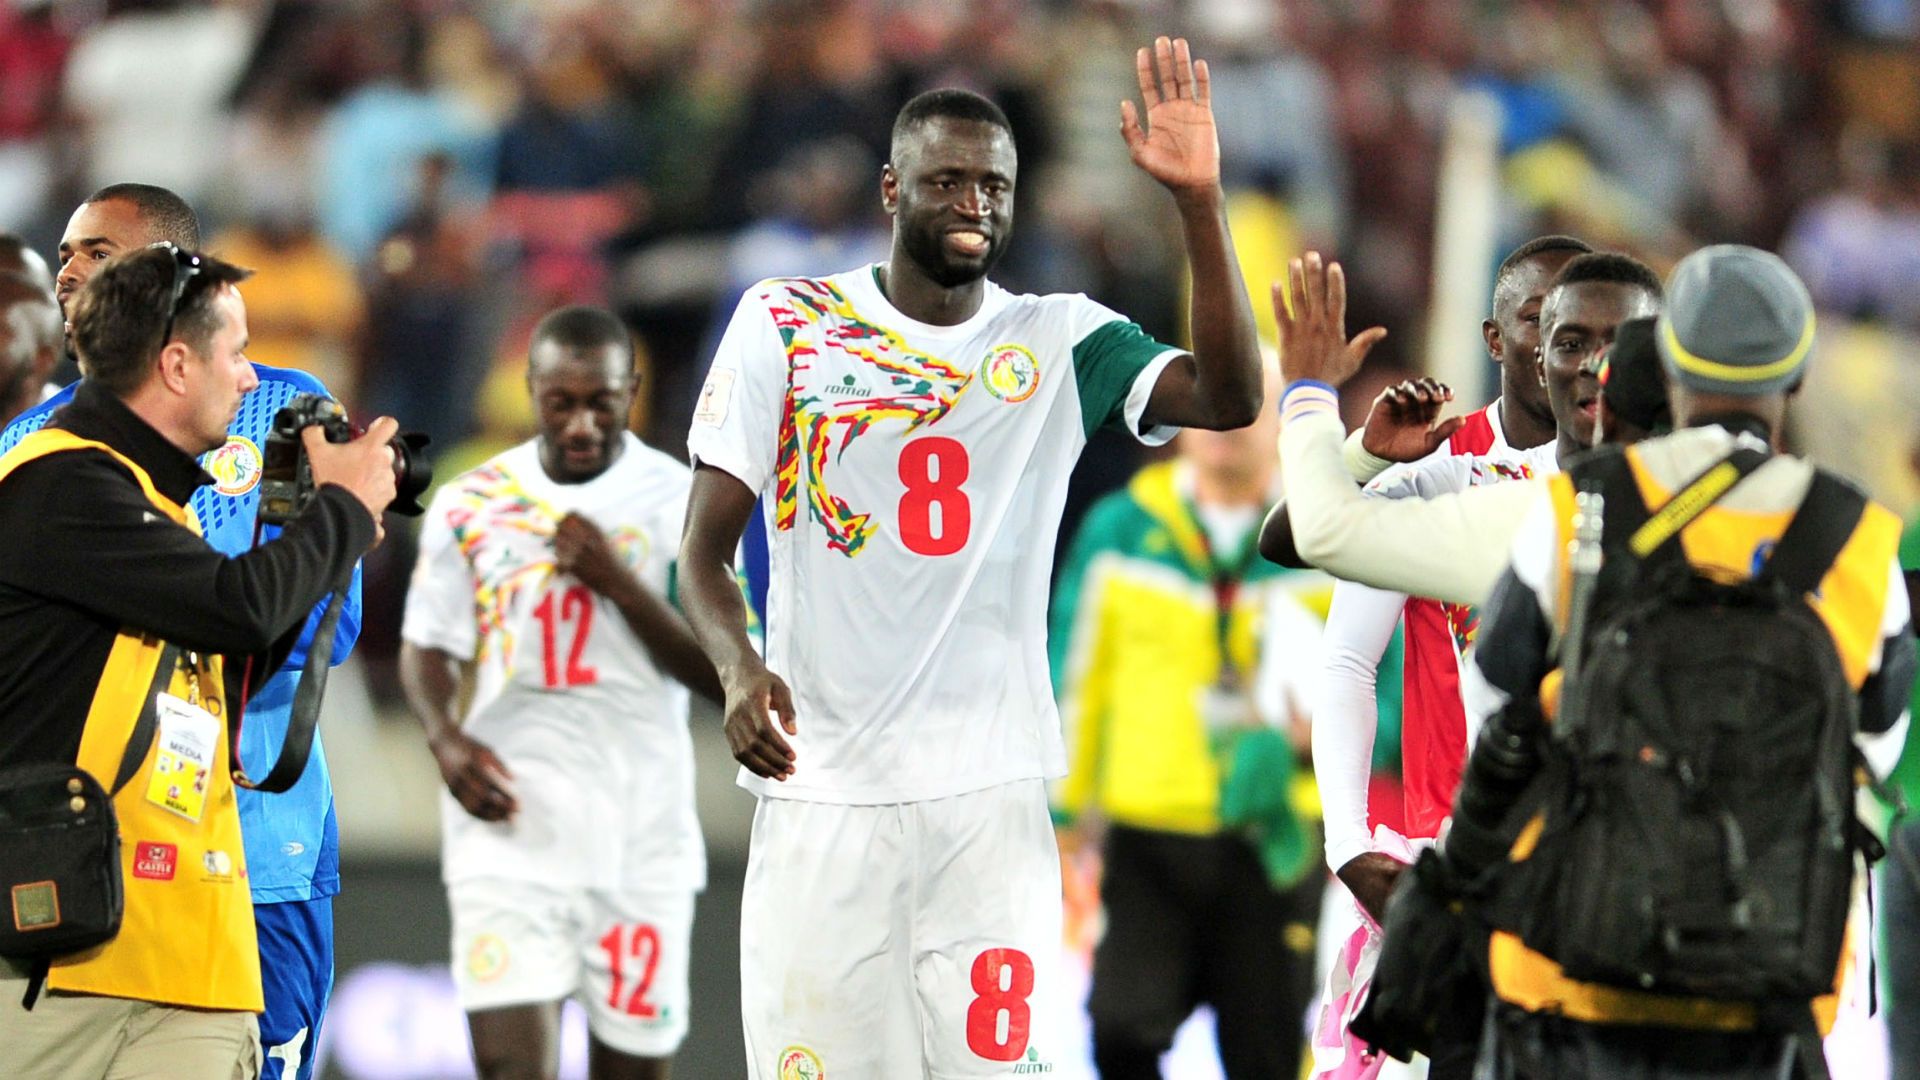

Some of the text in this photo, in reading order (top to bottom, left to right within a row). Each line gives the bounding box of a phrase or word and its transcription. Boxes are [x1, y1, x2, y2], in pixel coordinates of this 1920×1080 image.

[898, 436, 971, 556] 8
[532, 584, 598, 688] 12
[169, 741, 204, 762] MEDIA
[598, 922, 660, 1018] 12
[966, 947, 1035, 1062] 8
